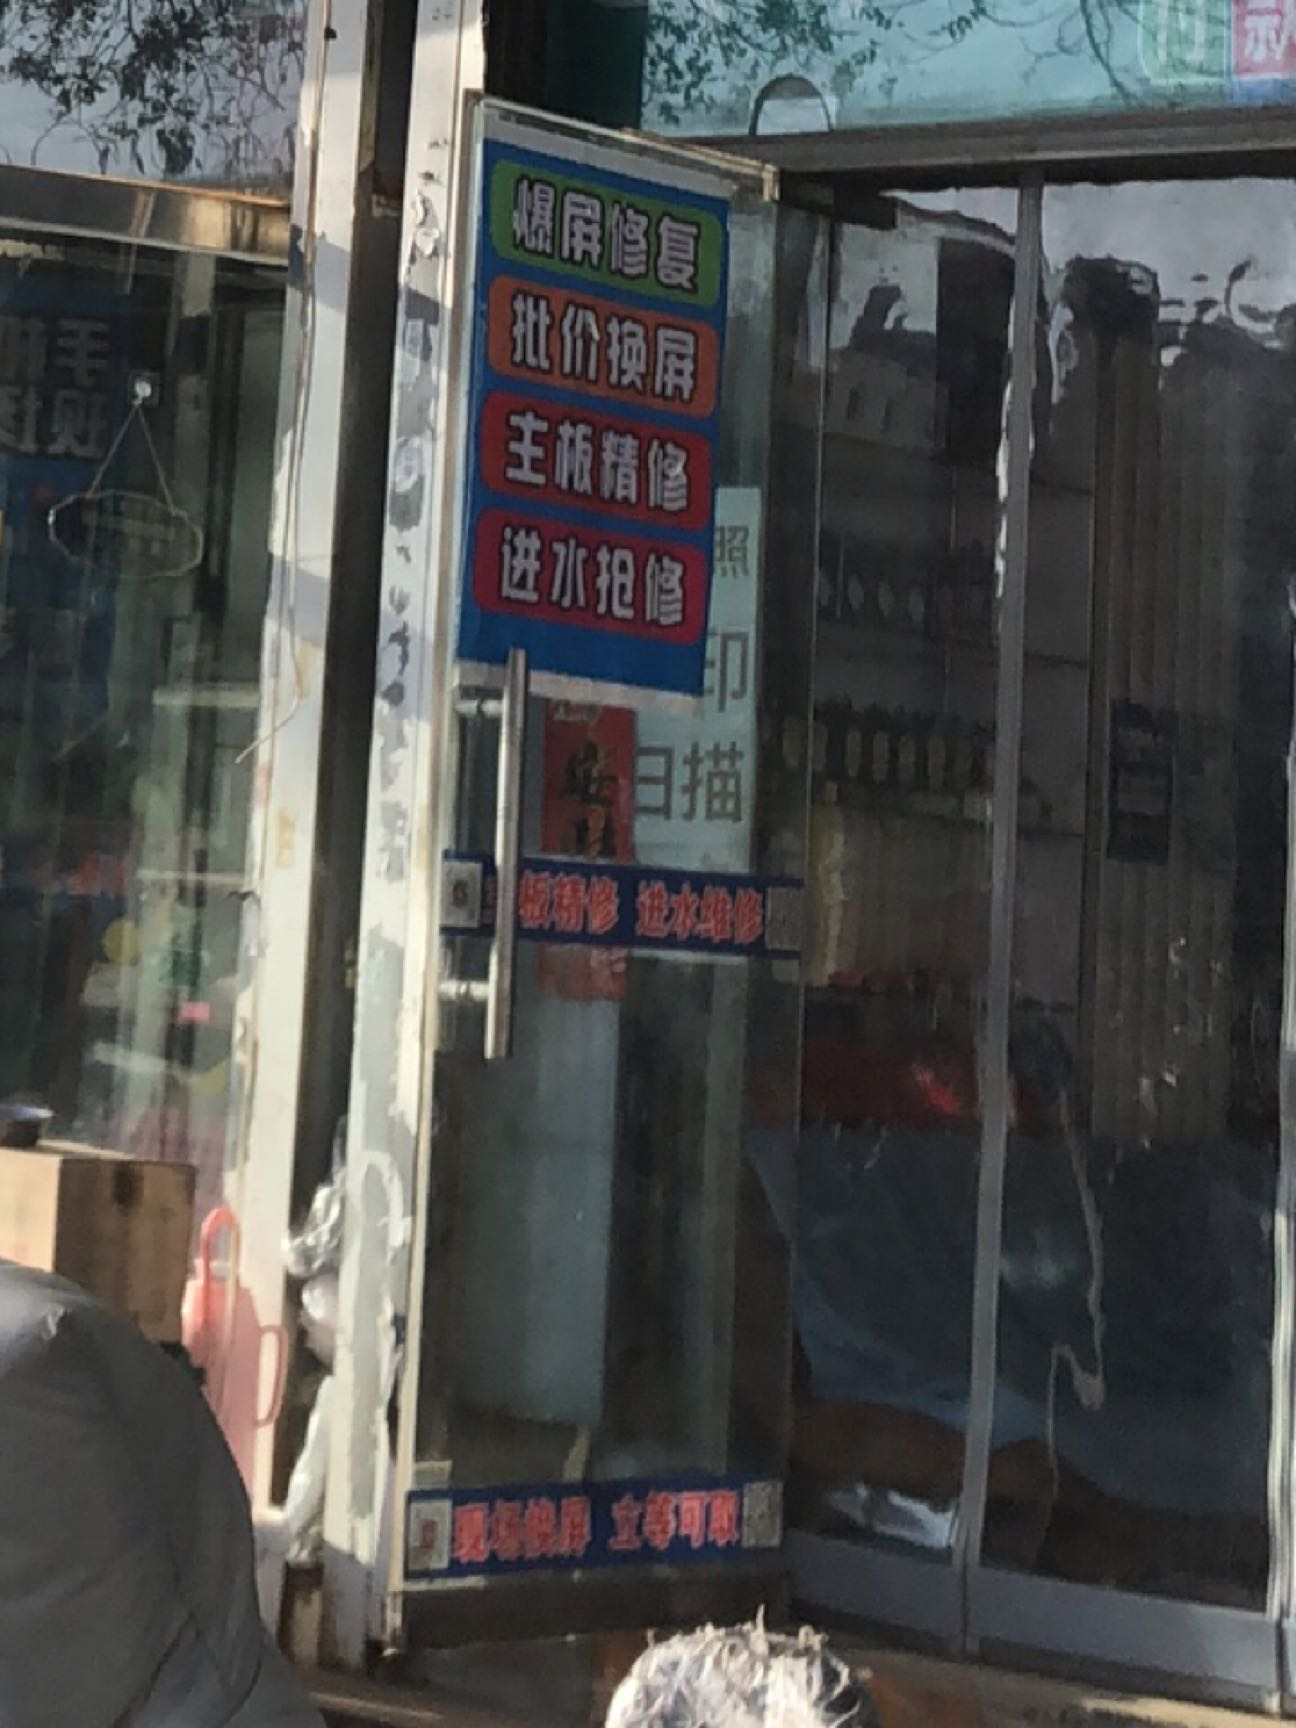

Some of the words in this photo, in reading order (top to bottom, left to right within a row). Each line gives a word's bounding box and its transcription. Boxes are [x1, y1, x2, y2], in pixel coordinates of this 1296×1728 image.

[512, 178, 701, 291] 爆屏修复
[510, 291, 697, 404] 批价换屏
[505, 409, 690, 513] 主板精修
[499, 525, 685, 626] 进水抢修
